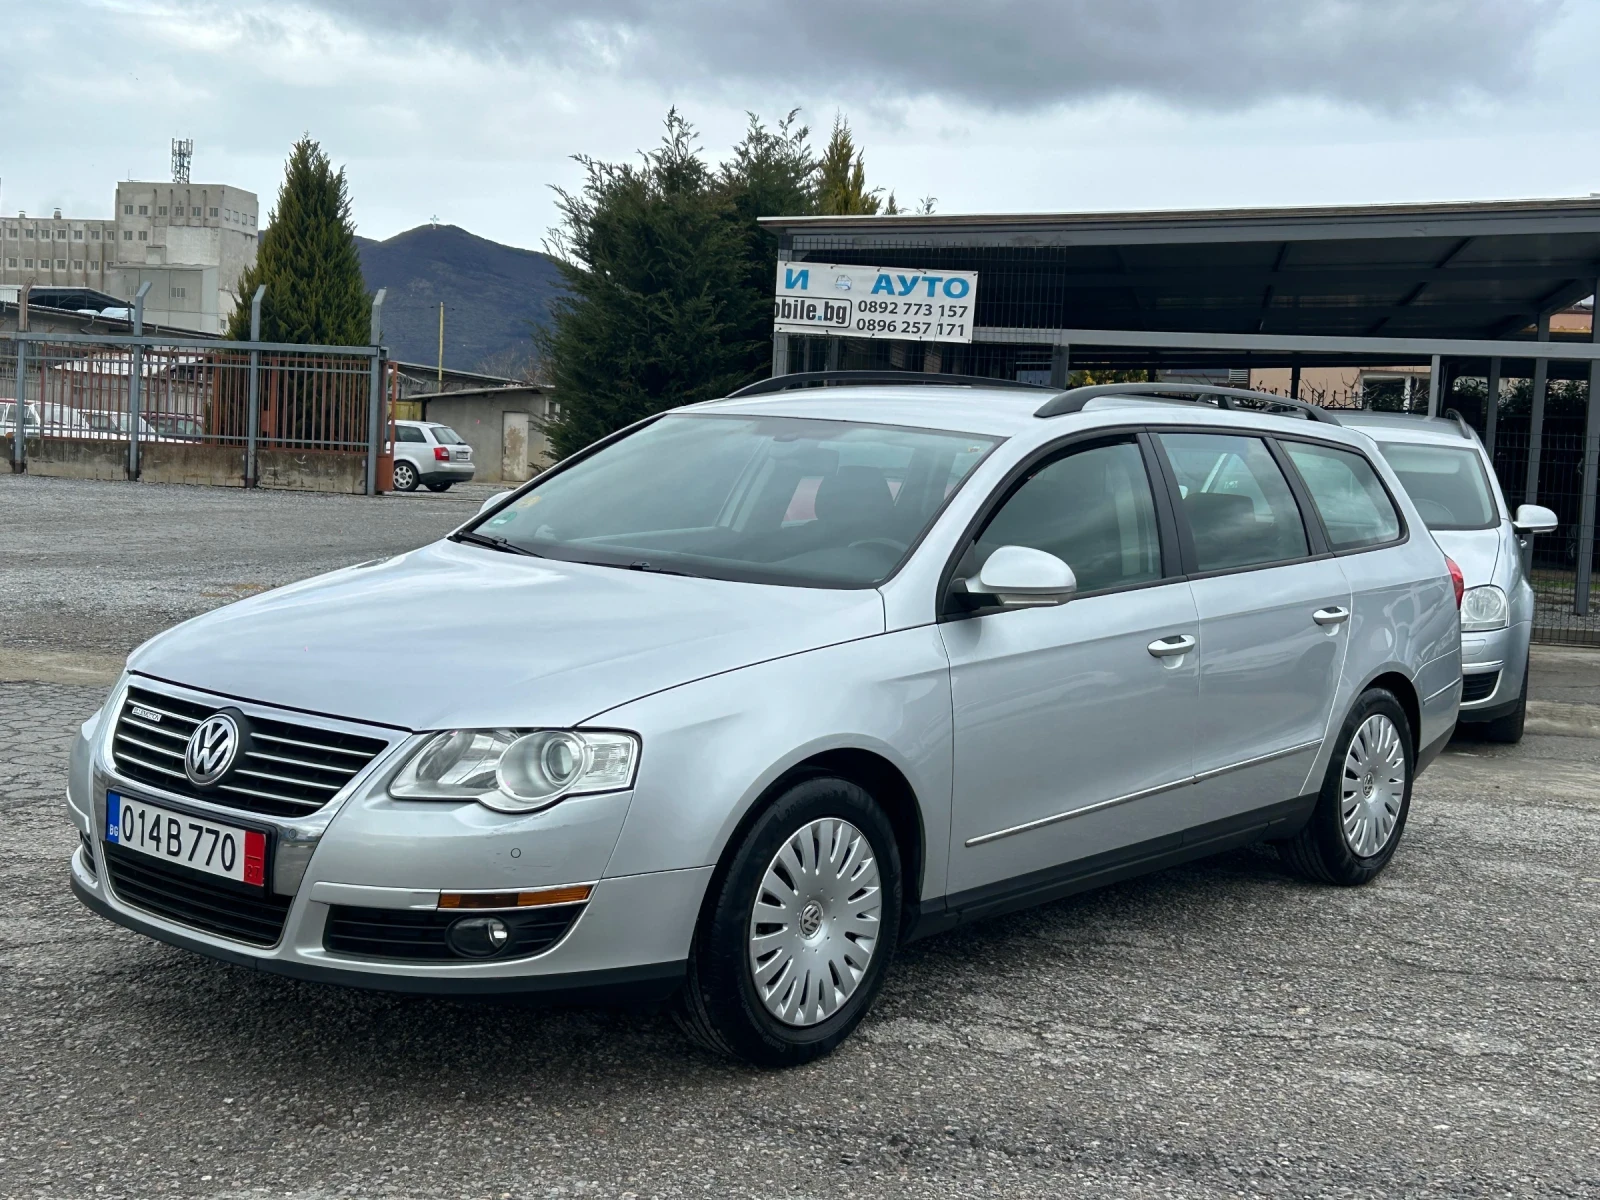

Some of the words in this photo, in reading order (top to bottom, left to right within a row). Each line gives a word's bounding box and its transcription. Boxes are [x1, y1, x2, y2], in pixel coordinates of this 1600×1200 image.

[785, 268, 809, 290] И
[870, 273, 970, 299] АУТО
[858, 300, 898, 315] 0892
[903, 302, 933, 316] 773
[938, 304, 968, 318] 157
[856, 318, 897, 333] 0896
[901, 321, 931, 335] 257
[937, 323, 965, 337] 171
[109, 824, 119, 837] BG
